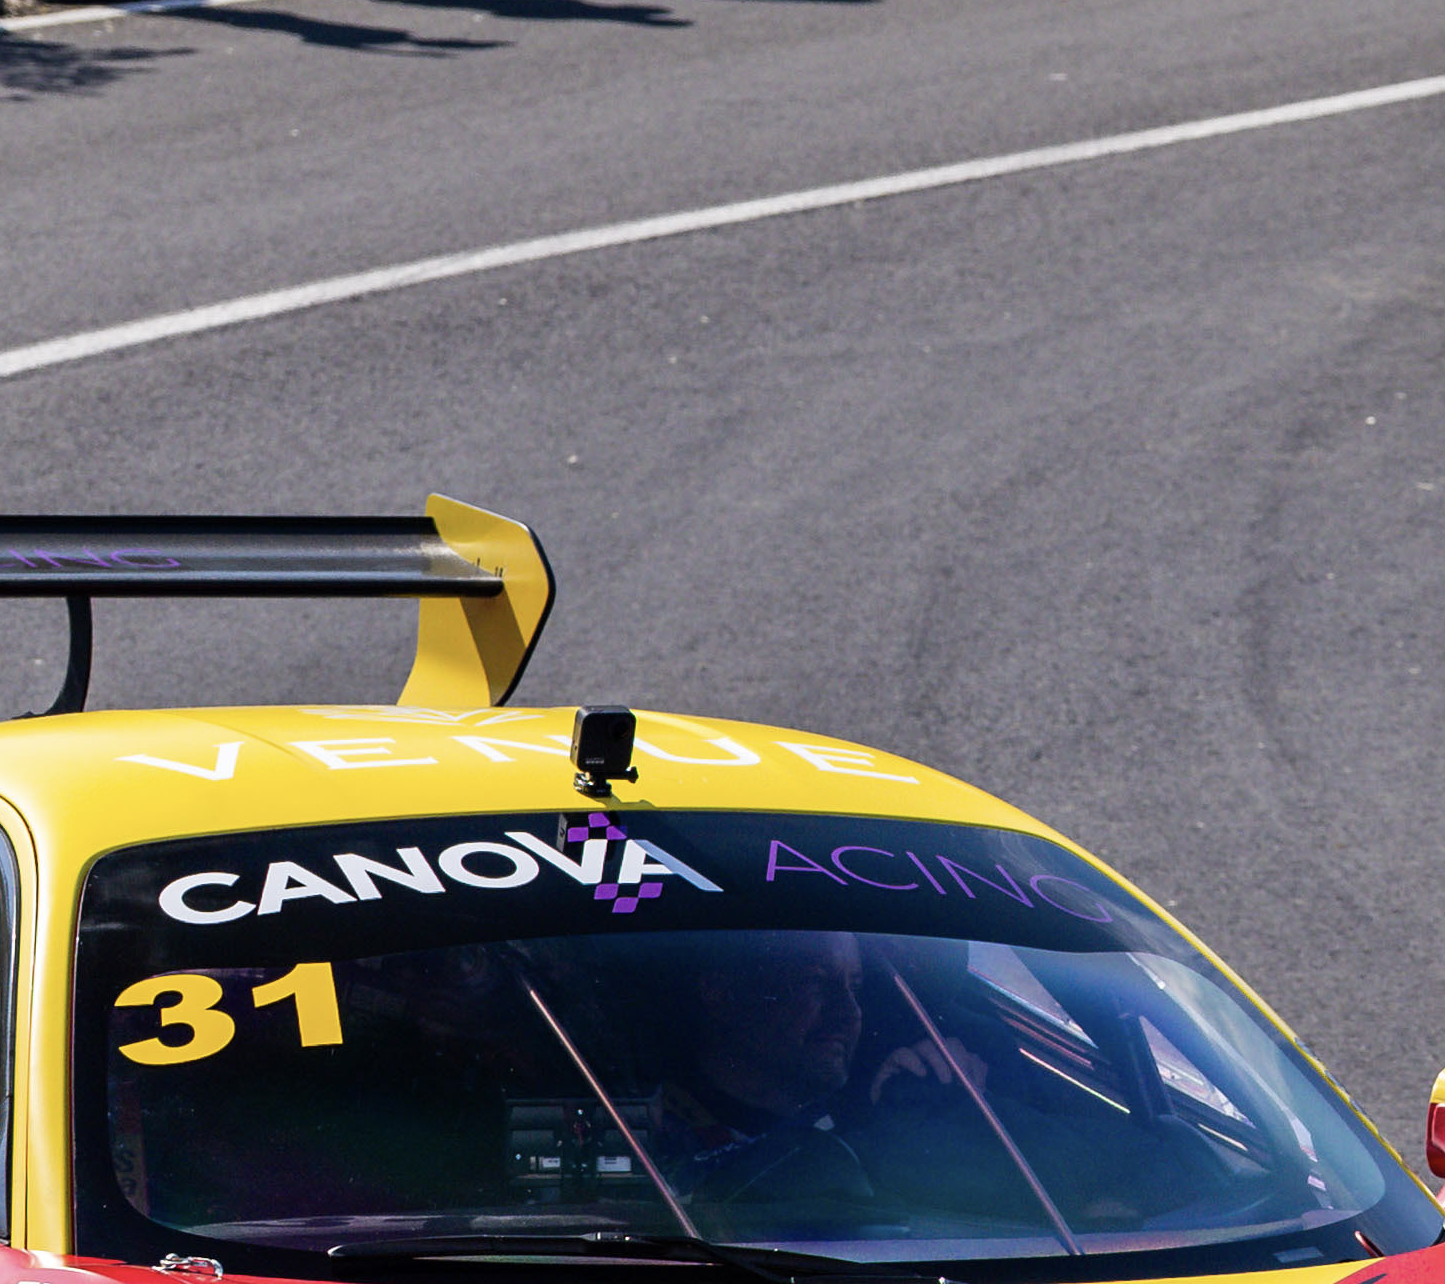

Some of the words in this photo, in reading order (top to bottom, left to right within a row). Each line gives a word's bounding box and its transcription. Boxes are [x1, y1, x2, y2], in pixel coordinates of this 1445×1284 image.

[116, 734, 921, 784] VENUE
[157, 830, 724, 925] CANOVA
[113, 961, 344, 1066] 31
